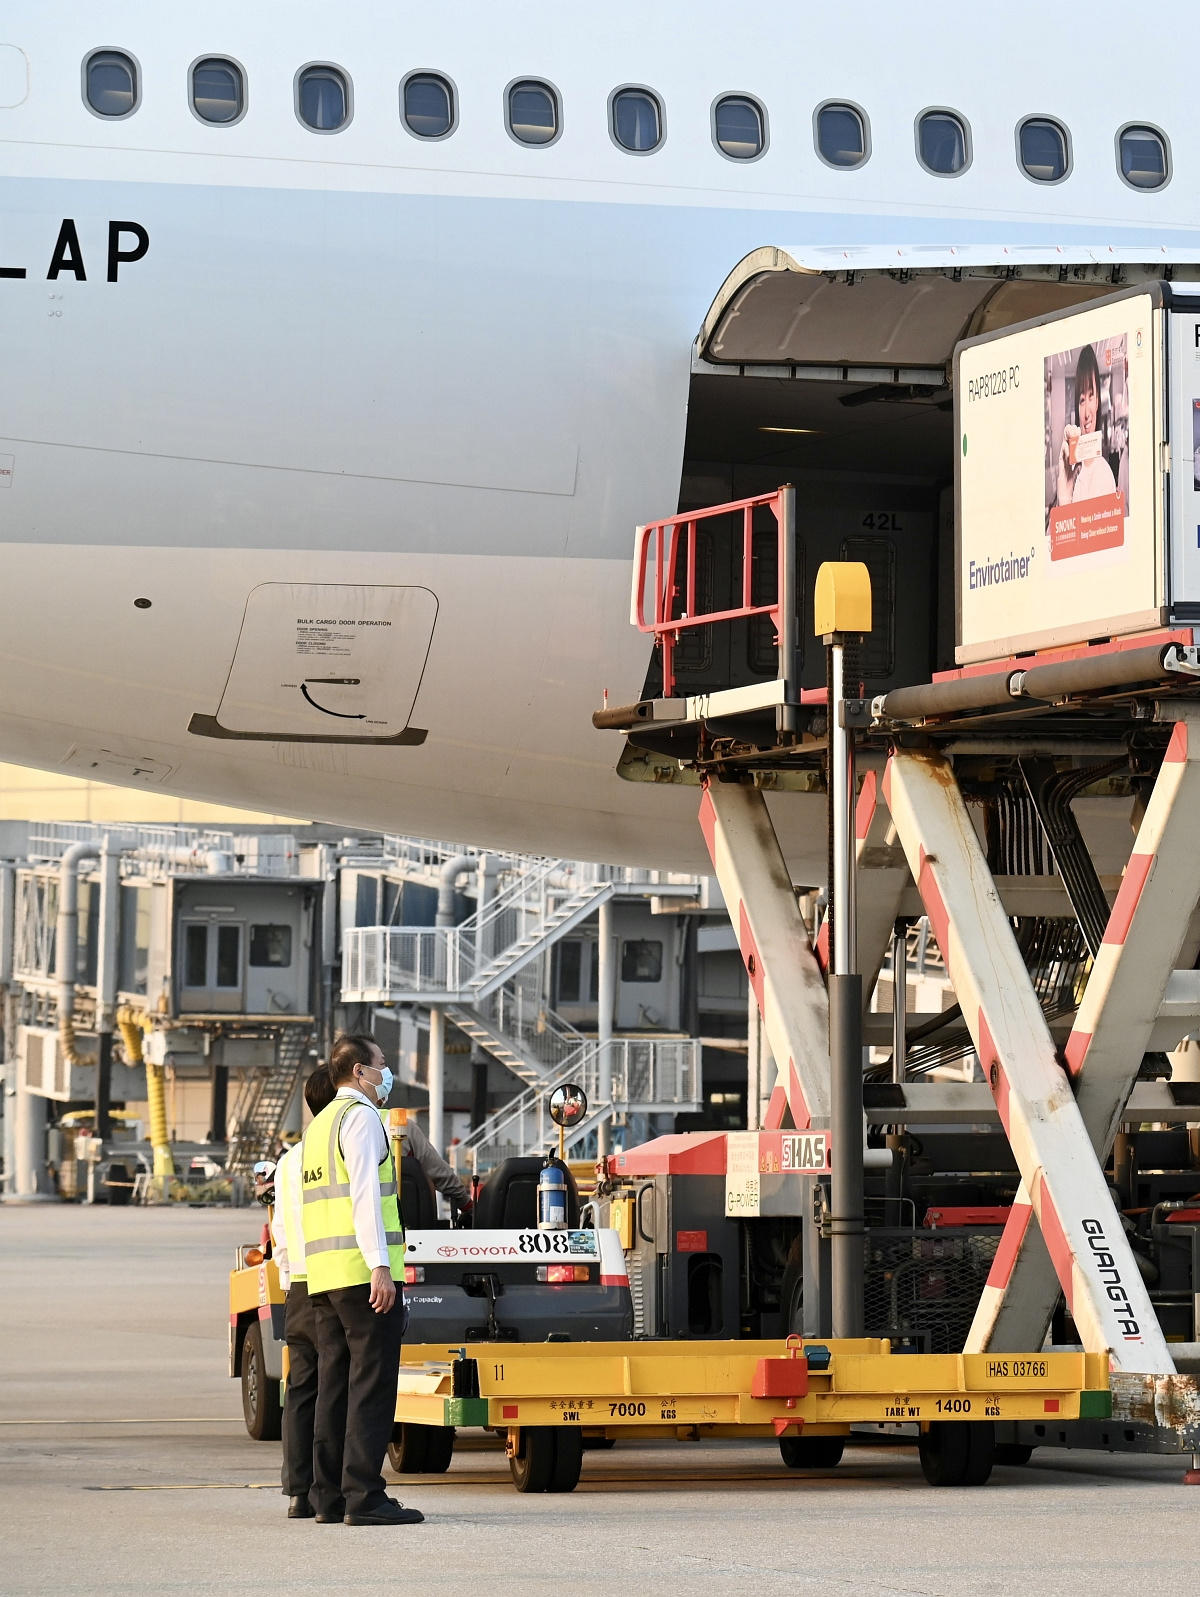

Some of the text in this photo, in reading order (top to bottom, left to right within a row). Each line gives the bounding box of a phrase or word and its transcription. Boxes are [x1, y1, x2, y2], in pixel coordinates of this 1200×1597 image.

[0, 219, 150, 283] AP
[968, 365, 1020, 402] RAP81228 PC
[862, 513, 903, 531] 42L
[460, 1246, 519, 1256] TOYOTA
[518, 1233, 569, 1254] 808
[1081, 1219, 1142, 1341] GUANGTAI
[413, 1296, 443, 1304] Capacity
[493, 1364, 505, 1381] 11
[990, 1362, 1046, 1377] HAS 03766
[608, 1403, 646, 1417] 7000
[885, 1407, 1000, 1417] TARE WT KGS
[935, 1399, 971, 1413] 1400
[563, 1410, 676, 1421] SWL KGS
